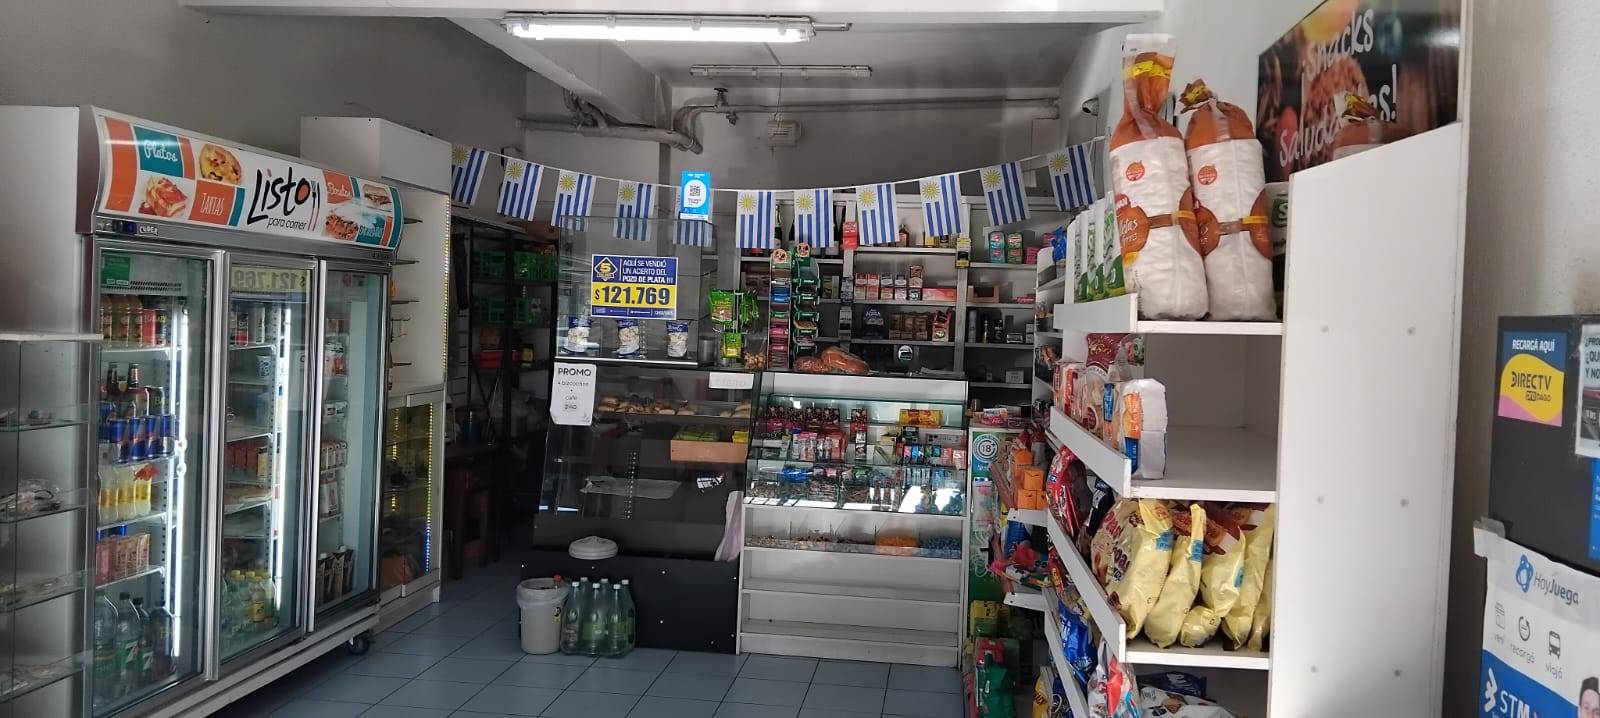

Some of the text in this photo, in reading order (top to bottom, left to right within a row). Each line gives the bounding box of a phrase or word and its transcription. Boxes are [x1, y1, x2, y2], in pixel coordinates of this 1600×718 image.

[1306, 9, 1375, 80] snacks
[143, 140, 178, 162] Platos
[200, 193, 225, 216] TARTAS
[246, 166, 311, 225] Listo
[267, 216, 307, 231] para comer
[622, 258, 637, 267] AQUÍ
[645, 259, 667, 268] VENDIÓ
[647, 276, 666, 284] PLATA
[595, 286, 670, 305] $ 121.769
[1512, 339, 1555, 353] RECARGÁ AQUÍ
[558, 367, 592, 377] PROMO
[1511, 371, 1552, 391] DIRECTV
[1585, 368, 1590, 378] Y
[1534, 571, 1579, 606] HoyJuega
